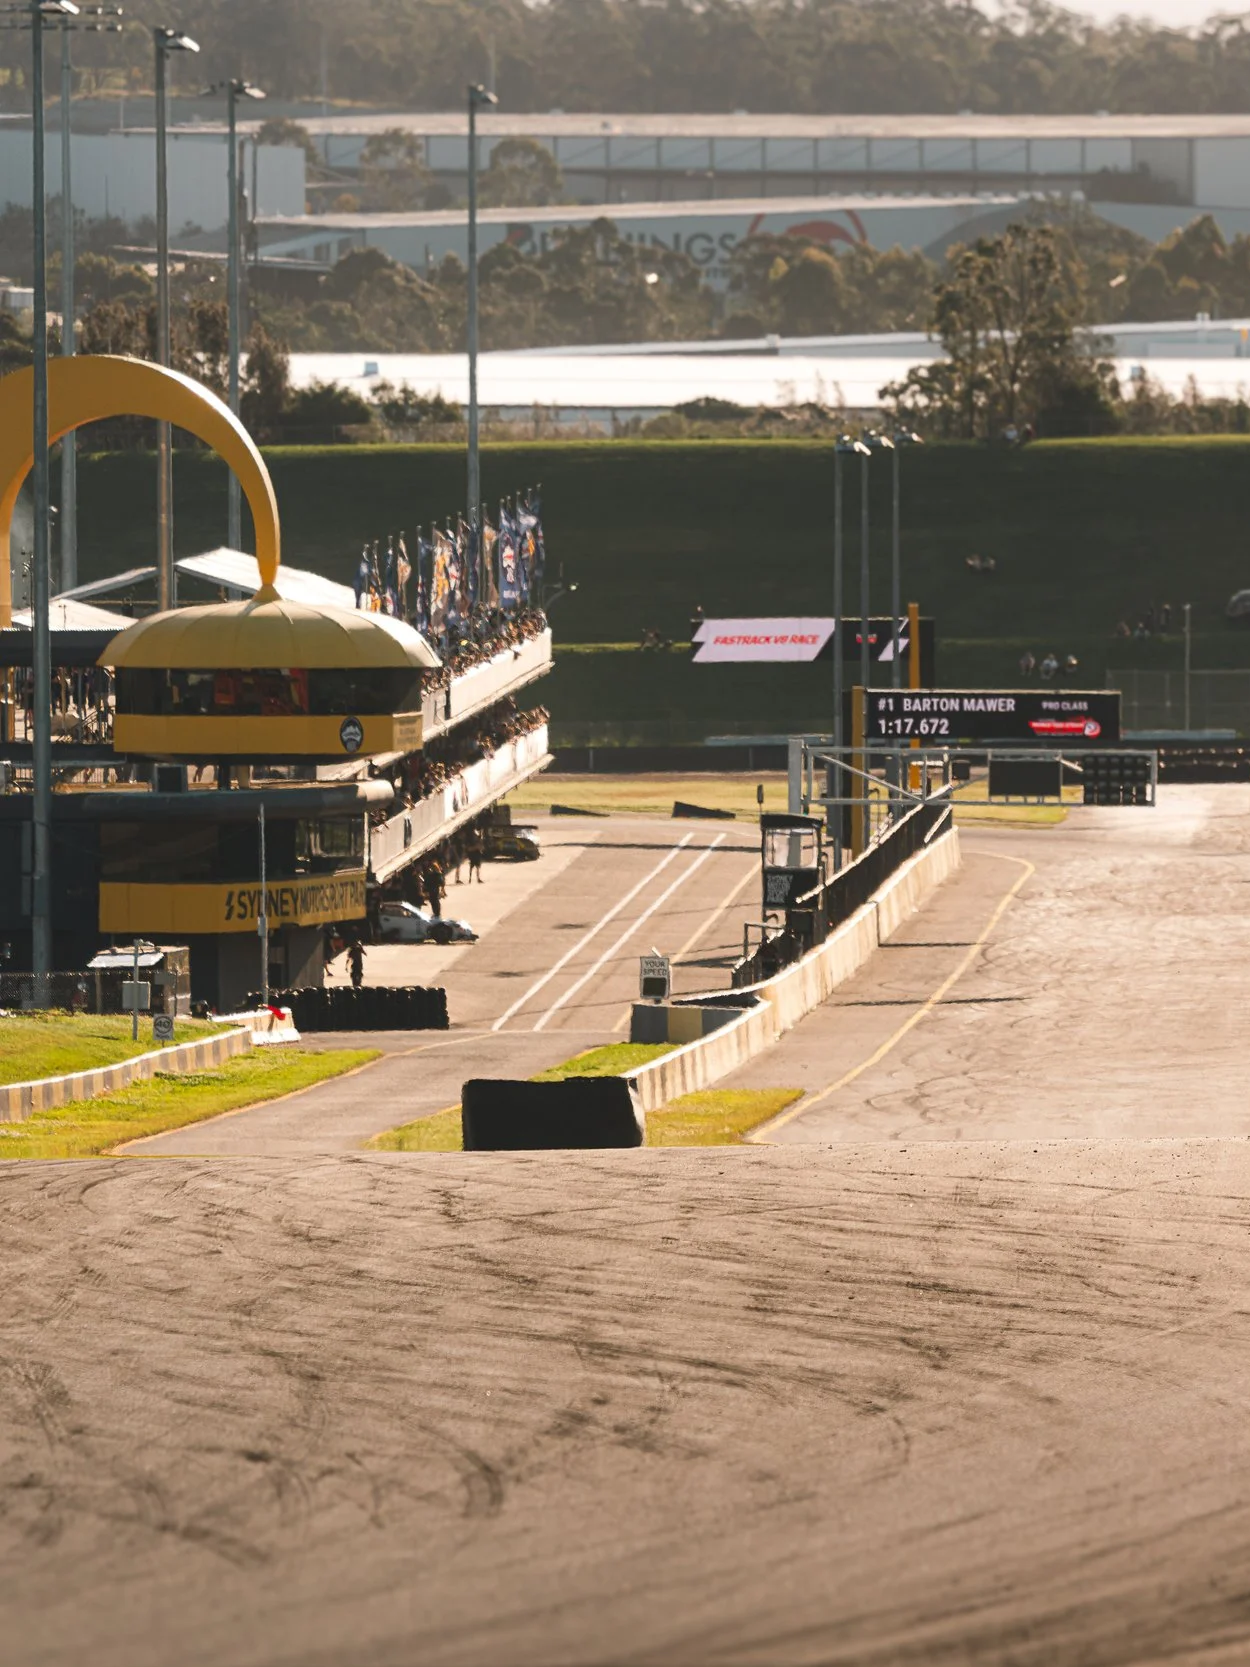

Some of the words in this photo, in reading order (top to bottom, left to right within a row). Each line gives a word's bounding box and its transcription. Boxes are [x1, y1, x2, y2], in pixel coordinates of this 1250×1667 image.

[507, 223, 738, 266] BNINGS
[713, 635, 770, 645] FASTRACK
[790, 634, 819, 644] RACE
[878, 698, 894, 712] #1
[903, 698, 959, 712] BARTON
[963, 698, 1016, 712] MAWER
[1061, 701, 1089, 711] CLASS
[878, 718, 949, 735] 1:17.672
[644, 960, 666, 968] YOUR
